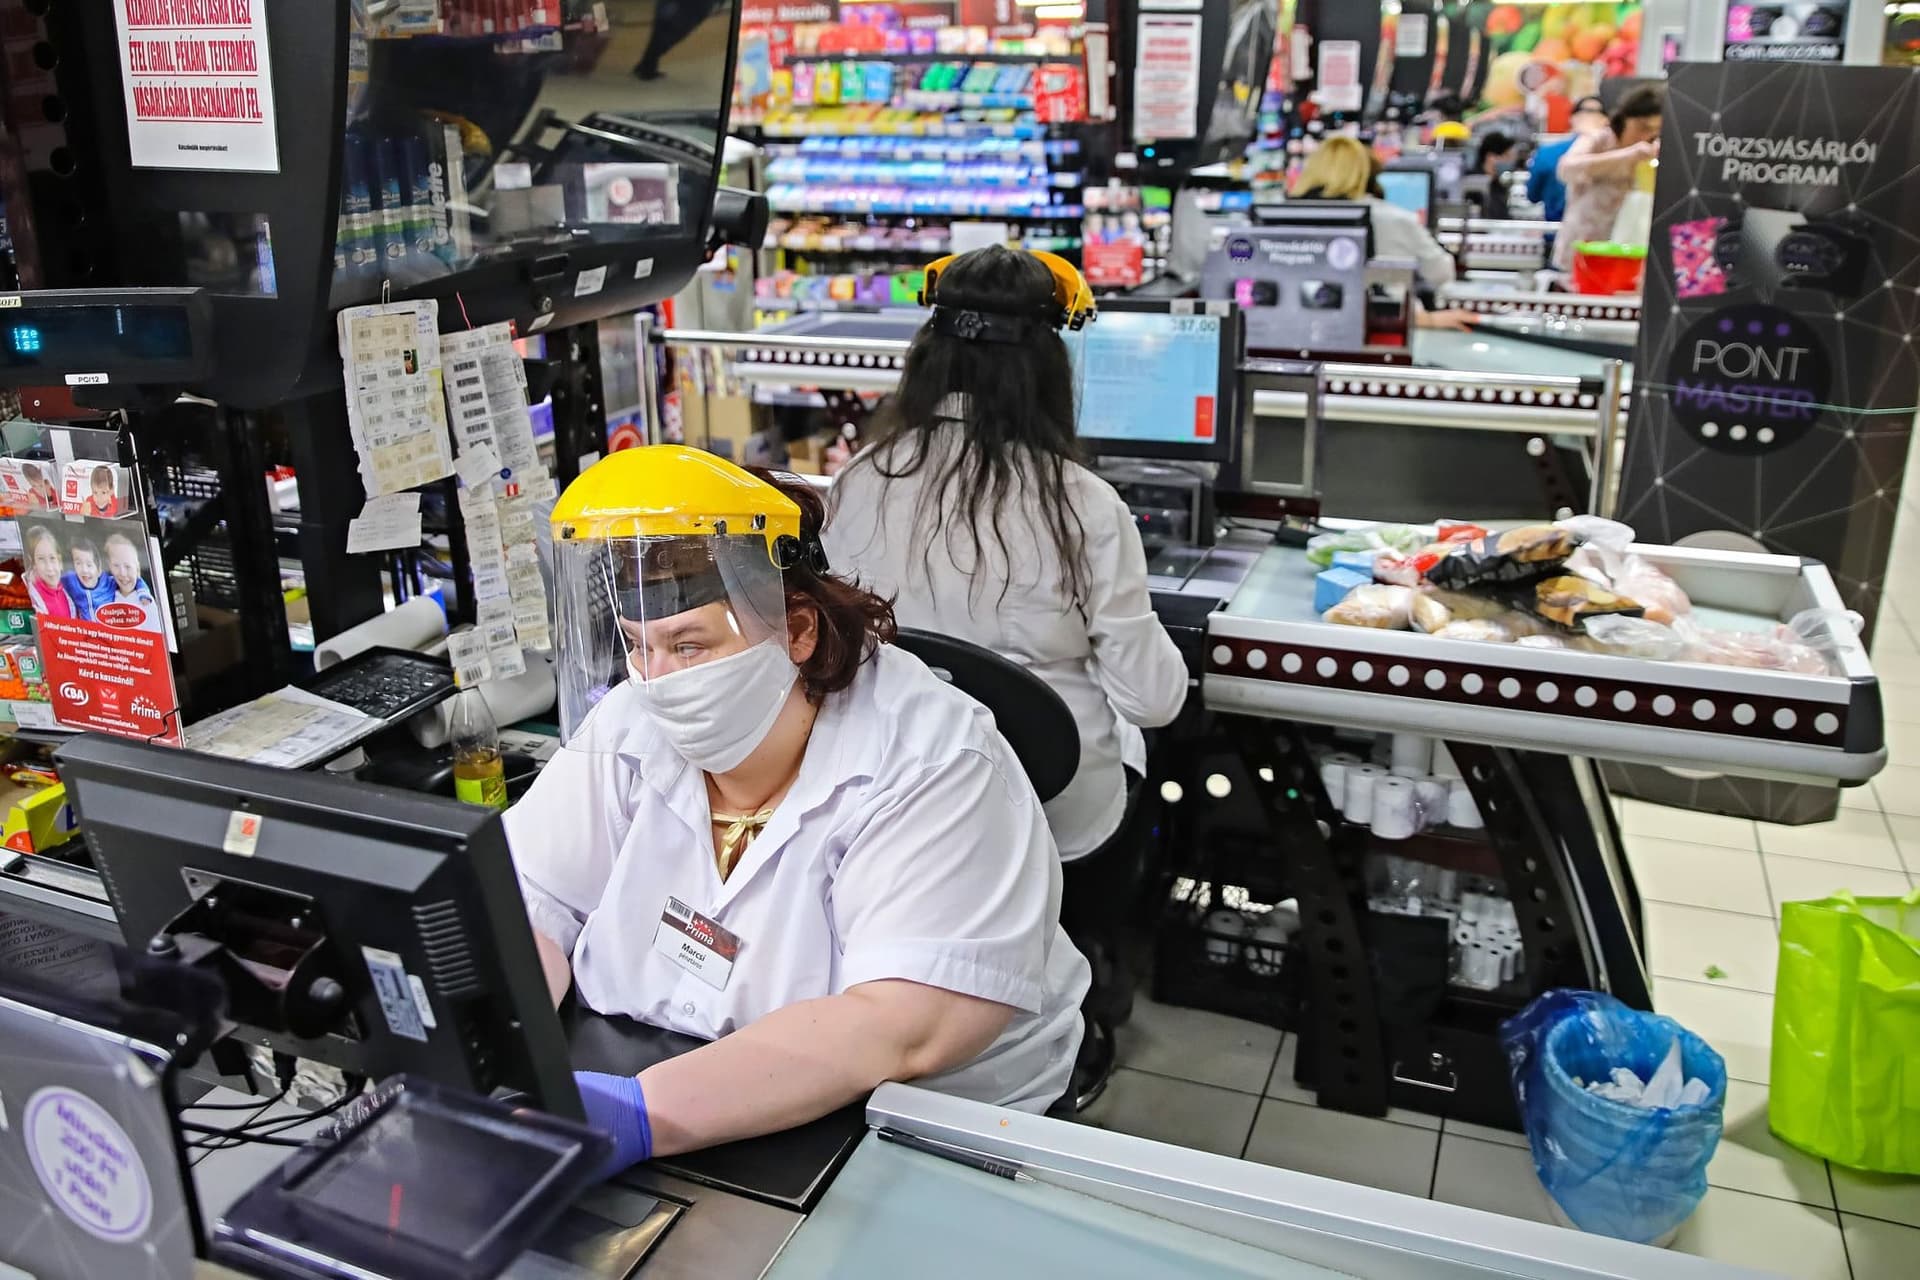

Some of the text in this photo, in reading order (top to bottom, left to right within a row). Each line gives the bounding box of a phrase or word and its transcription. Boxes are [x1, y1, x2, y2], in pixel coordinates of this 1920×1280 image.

[129, 35, 147, 71] ÉTEL
[208, 34, 257, 71] TEJTERMÉK)
[133, 81, 263, 118] VÁSÁRLÁSÁRA HASZNÁLHATÓ FEL.
[1693, 132, 1877, 163] TÖRZSVÁSÁRLÓI
[1721, 158, 1839, 186] PROGRAM
[428, 162, 448, 244] Gillette
[1692, 339, 1809, 382] PONT
[1674, 378, 1815, 419] MASTER
[64, 687, 85, 701] CBA
[131, 702, 160, 720] Prima
[685, 922, 714, 945] Prima
[682, 942, 707, 962] Marcsi
[69, 1181, 112, 1224] Pont
